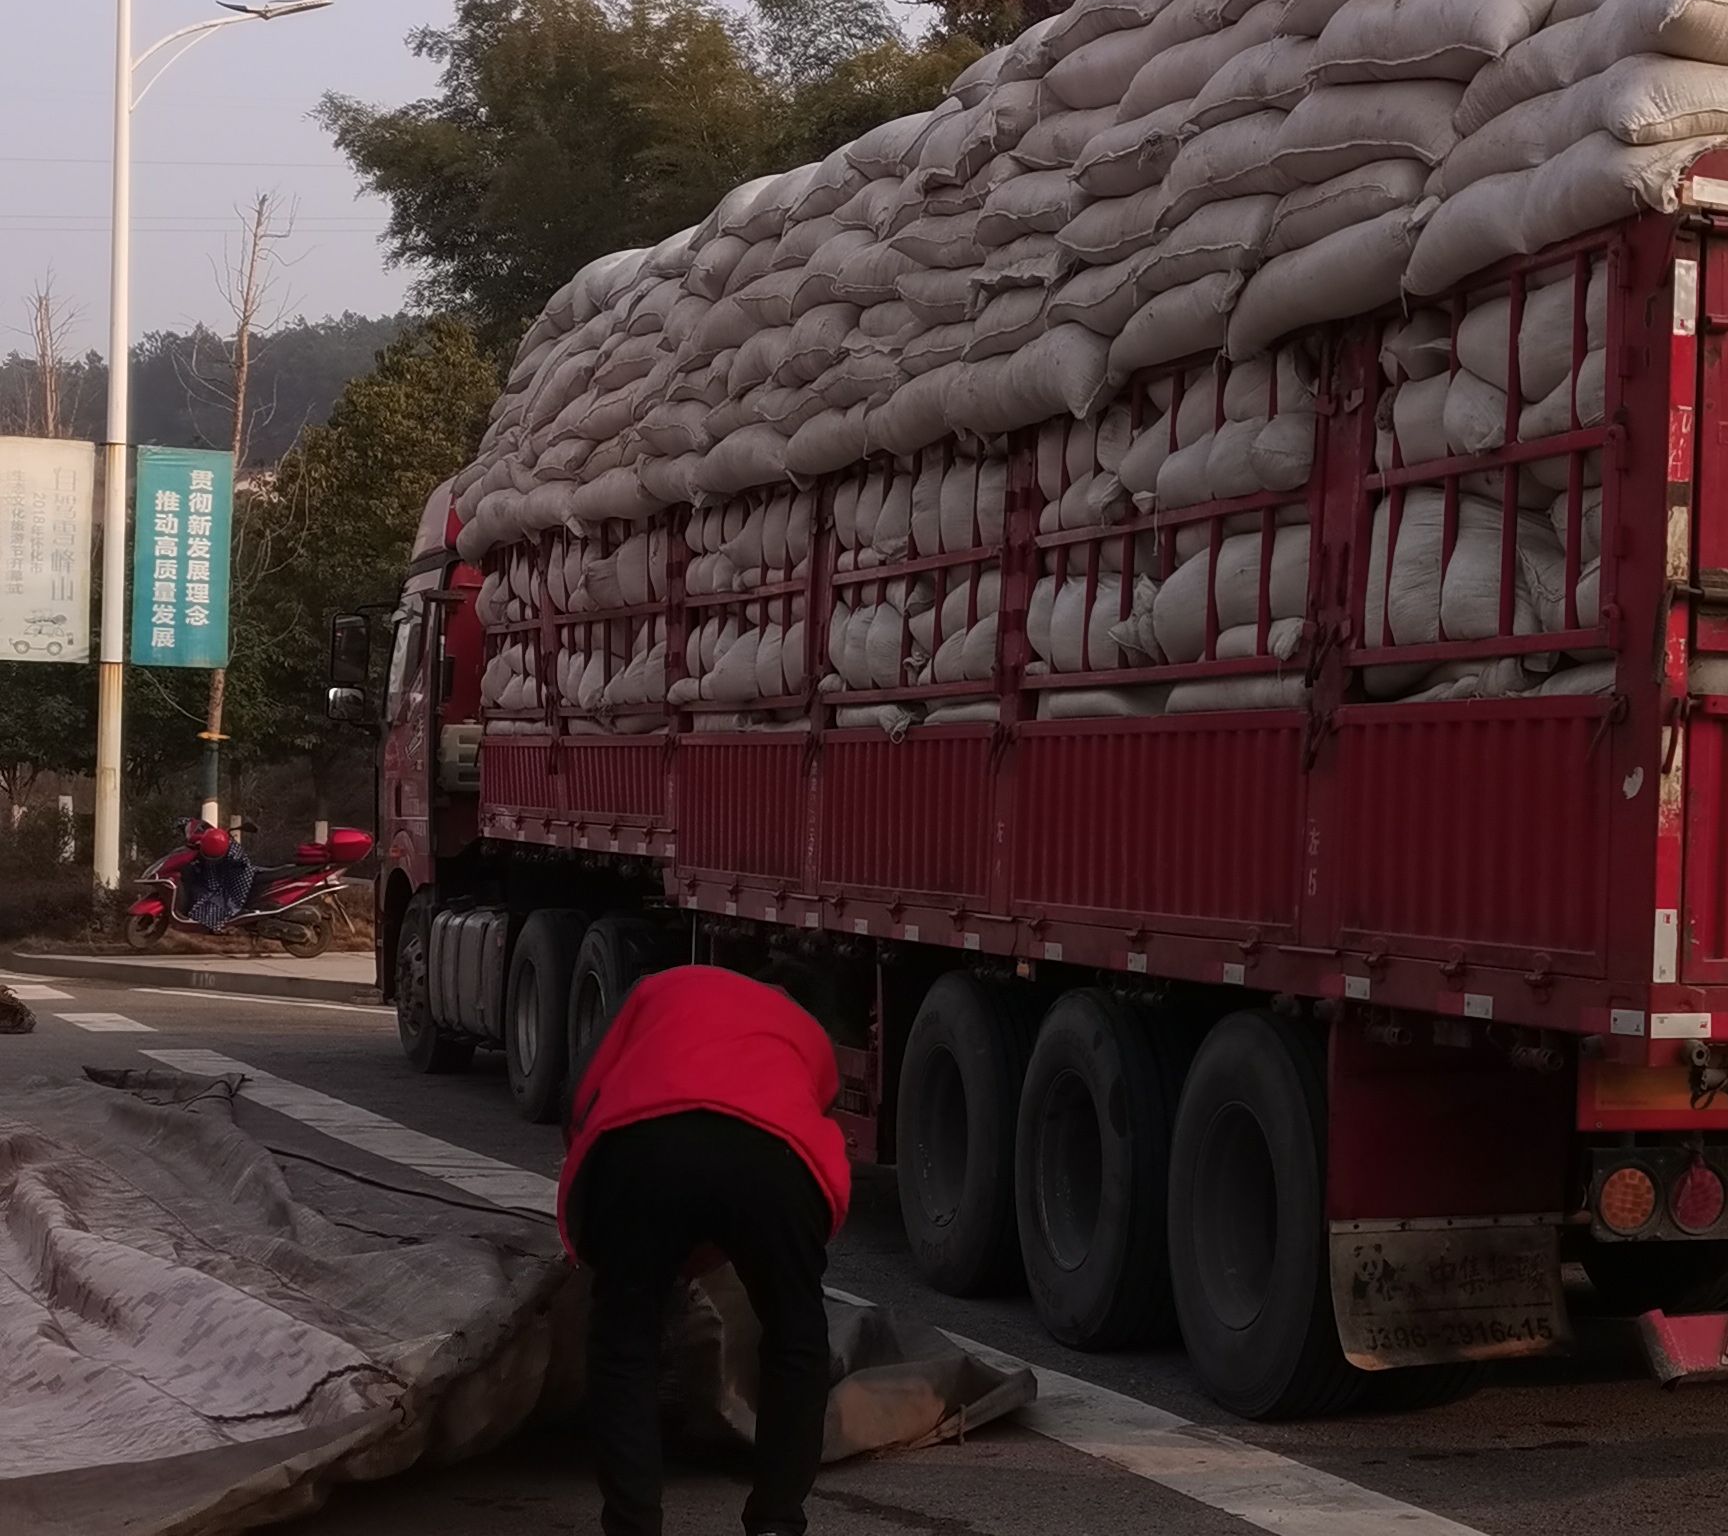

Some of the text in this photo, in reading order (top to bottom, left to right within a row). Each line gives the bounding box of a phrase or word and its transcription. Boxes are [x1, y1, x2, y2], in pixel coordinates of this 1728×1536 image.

[151, 490, 180, 648] 推动高质量发展
[185, 469, 214, 626] 贯彻新发展理念
